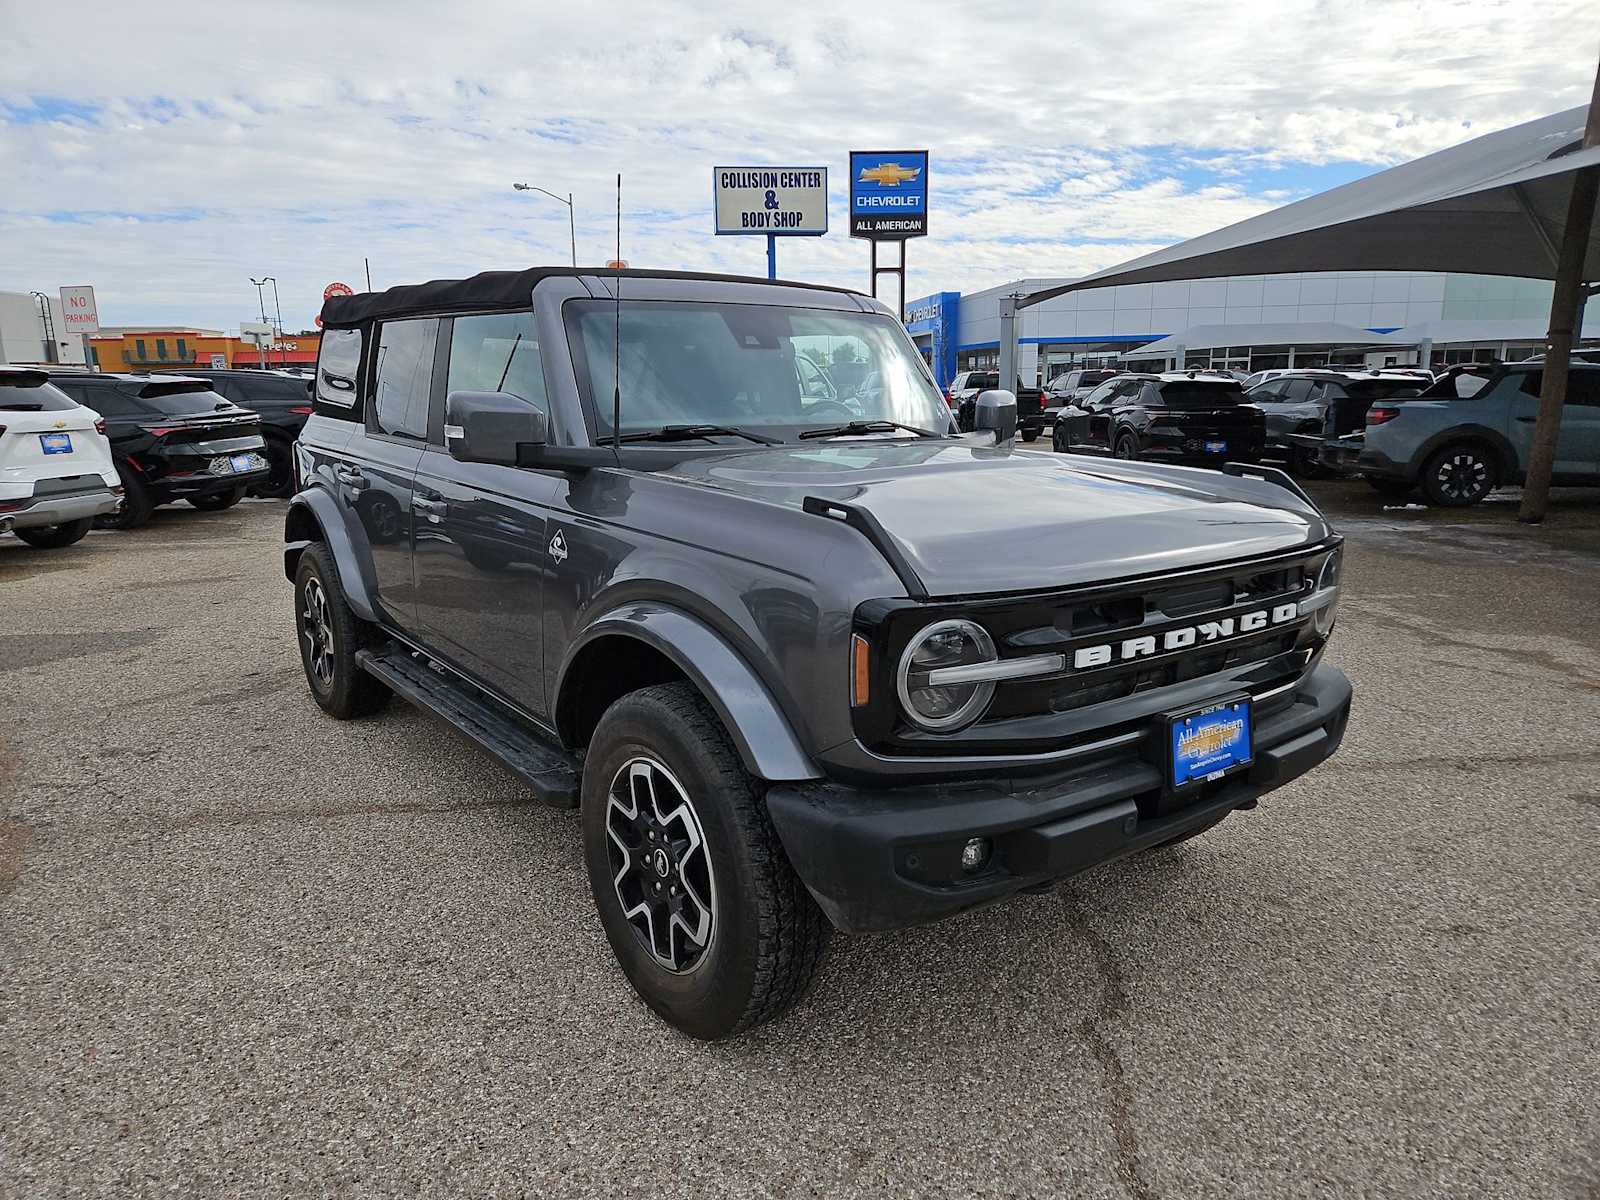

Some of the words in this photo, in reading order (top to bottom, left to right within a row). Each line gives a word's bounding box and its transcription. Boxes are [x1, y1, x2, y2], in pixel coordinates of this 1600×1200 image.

[721, 172, 778, 188] COLLISION
[780, 172, 821, 188] CENTER
[764, 190, 779, 209] &
[856, 196, 921, 207] CHEVROLET
[741, 212, 771, 228] BODY
[773, 212, 803, 228] SHOP
[856, 220, 873, 231] ALL
[875, 220, 922, 231] AMERICAN
[69, 296, 87, 308] NO
[65, 313, 96, 323] PARKING
[1074, 602, 1298, 669] BRONCO
[1177, 728, 1193, 747] All
[1197, 718, 1244, 742] American
